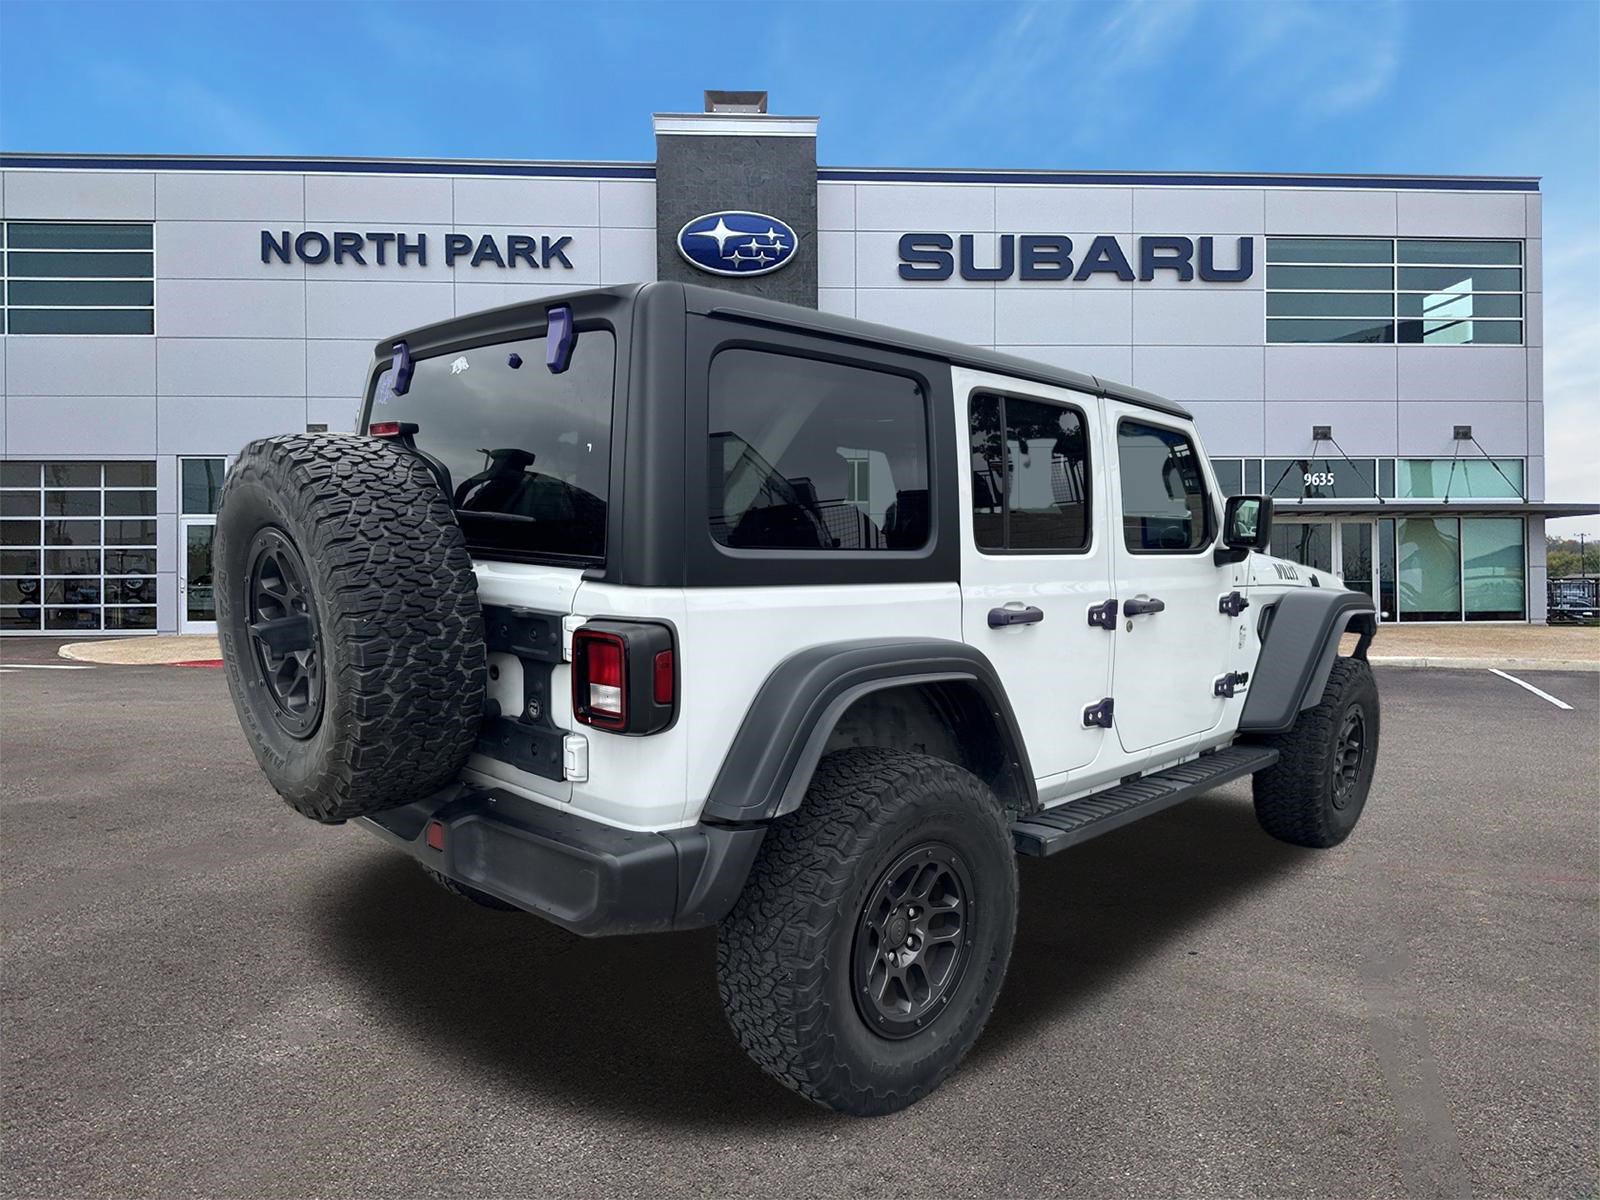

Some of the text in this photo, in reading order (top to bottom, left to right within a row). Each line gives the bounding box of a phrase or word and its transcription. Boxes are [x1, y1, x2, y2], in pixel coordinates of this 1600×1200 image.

[260, 230, 574, 269] NORTH PARK
[898, 233, 1254, 282] SUBARU
[1303, 472, 1335, 486] 9635
